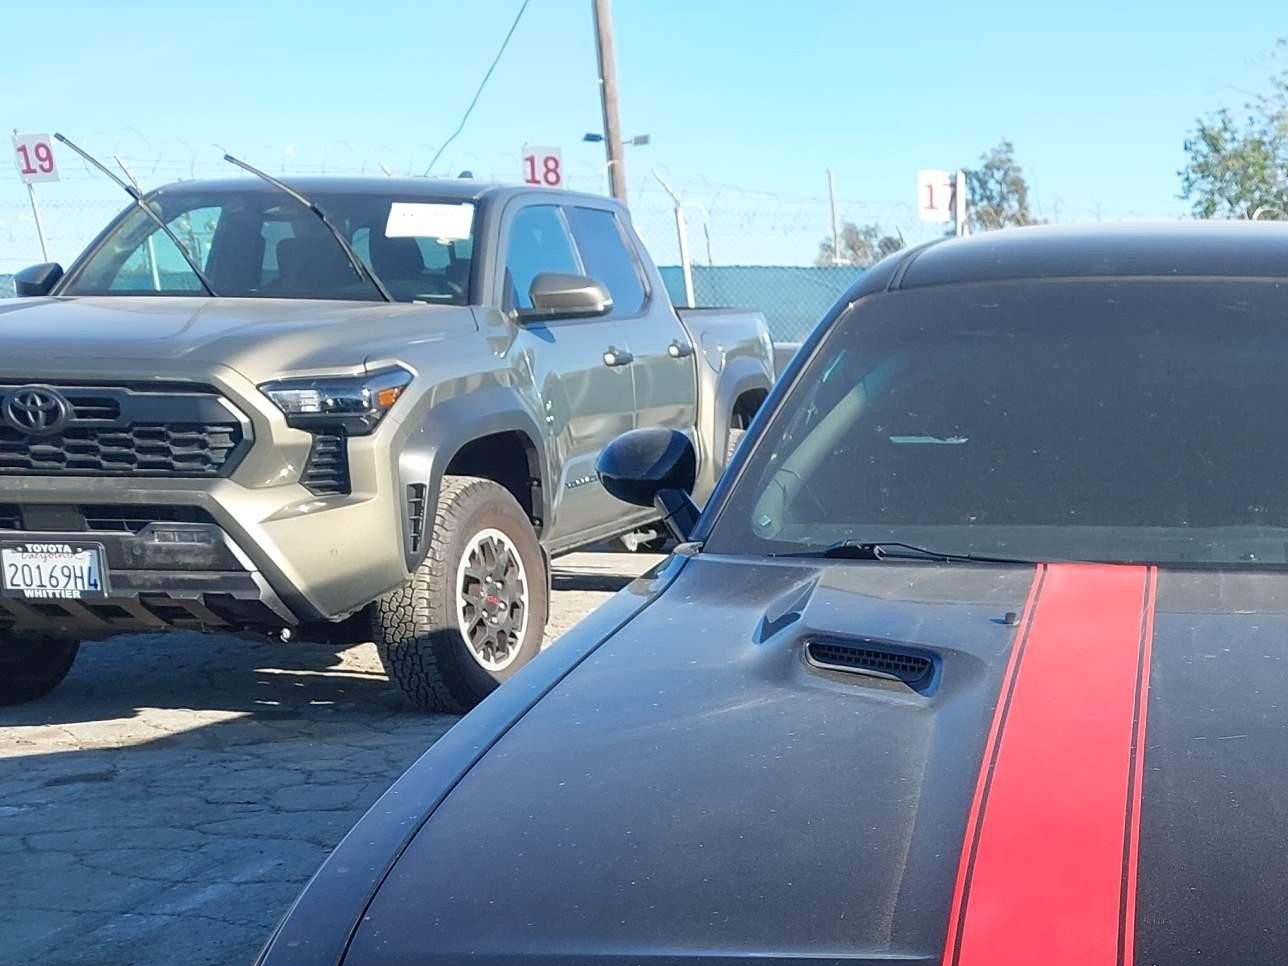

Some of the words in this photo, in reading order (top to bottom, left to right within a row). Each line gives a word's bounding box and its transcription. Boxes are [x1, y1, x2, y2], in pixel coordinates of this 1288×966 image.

[17, 143, 54, 175] 19
[524, 155, 561, 186] 18
[25, 543, 73, 553] TOYOTA
[8, 563, 99, 591] 20169H4
[23, 589, 82, 599] WHITTIER
